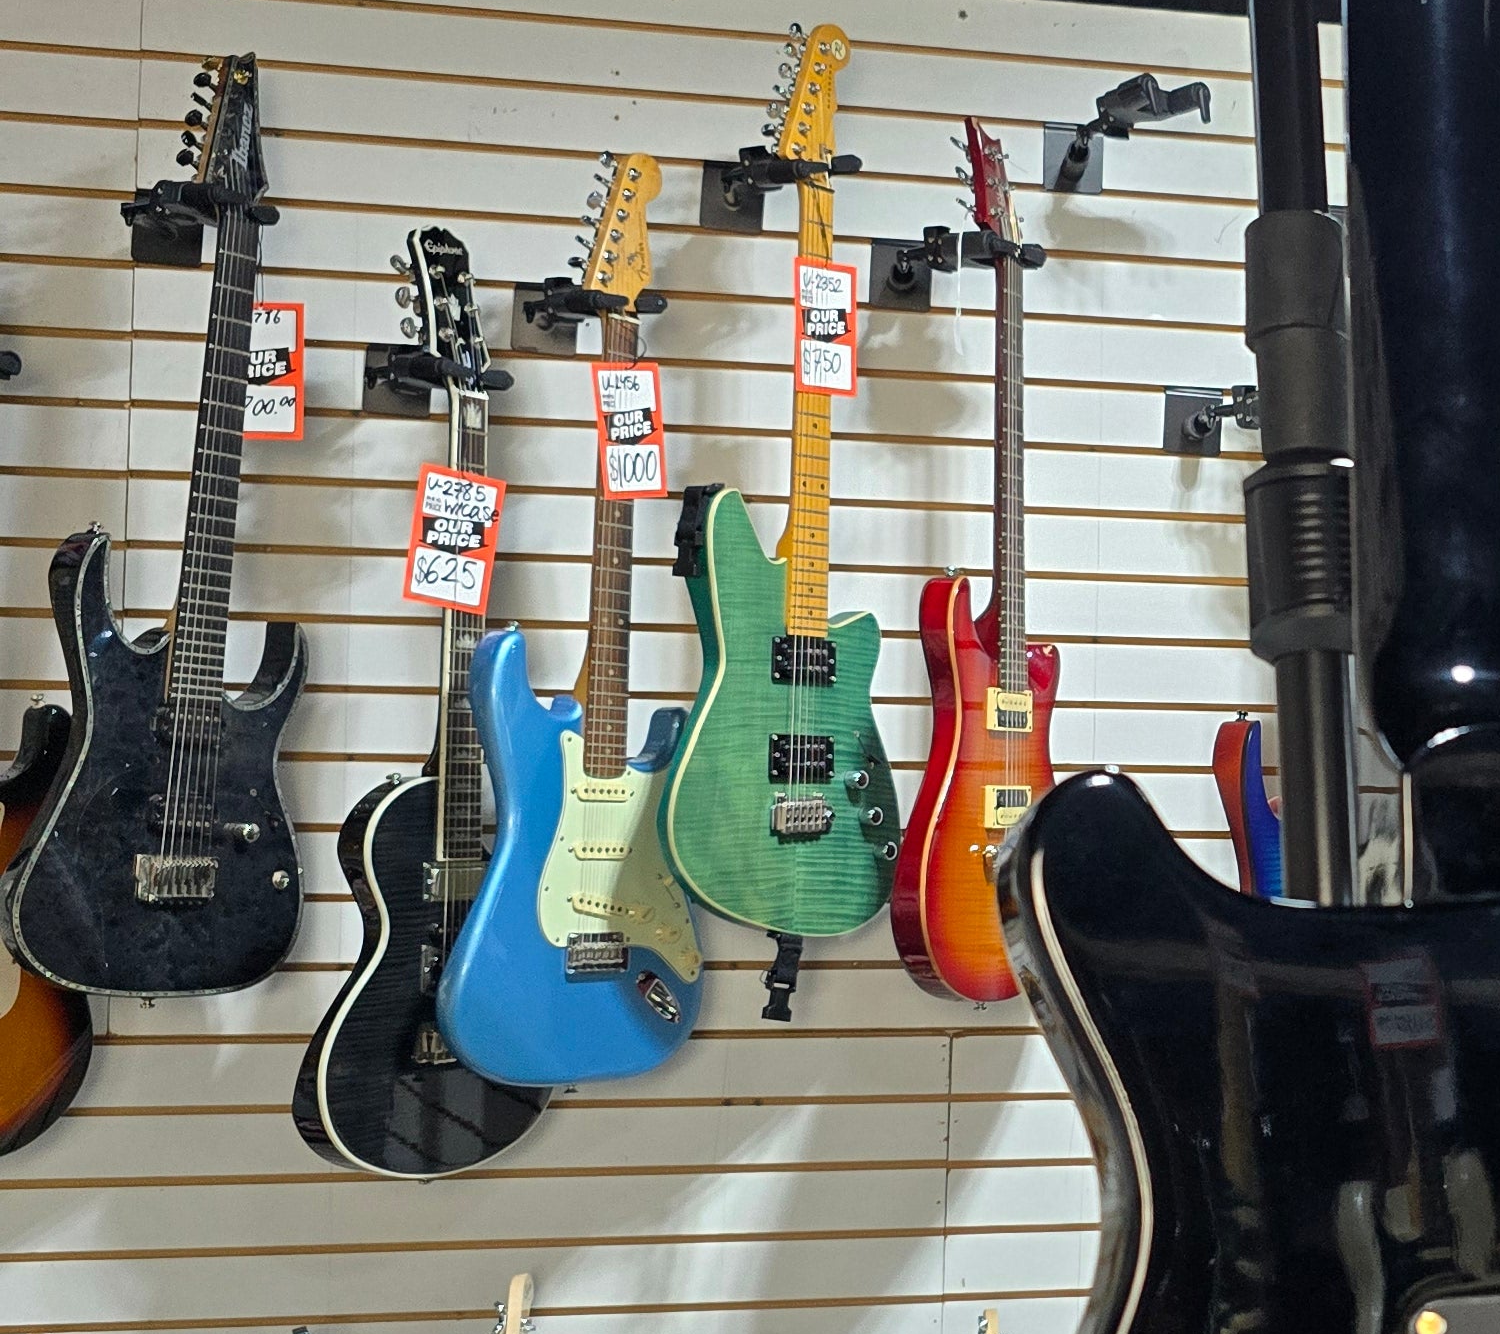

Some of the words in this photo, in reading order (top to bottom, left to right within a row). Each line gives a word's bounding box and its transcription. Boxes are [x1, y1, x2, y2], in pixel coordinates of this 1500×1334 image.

[231, 101, 254, 170] Ibanez
[423, 238, 463, 256] Epiphone
[254, 310, 281, 325] 776
[810, 310, 839, 323] OUR
[807, 322, 846, 336] PRICE
[250, 349, 278, 365] UR
[803, 348, 842, 375] $750
[247, 361, 288, 379] RICE
[245, 396, 296, 417] 700.00
[613, 410, 644, 427] OUR
[610, 421, 652, 441] PRICE
[609, 447, 657, 488] $1000
[427, 477, 487, 502] U-2785
[434, 518, 474, 534] OUR
[426, 529, 482, 548] PRICE
[415, 555, 478, 589] $625
